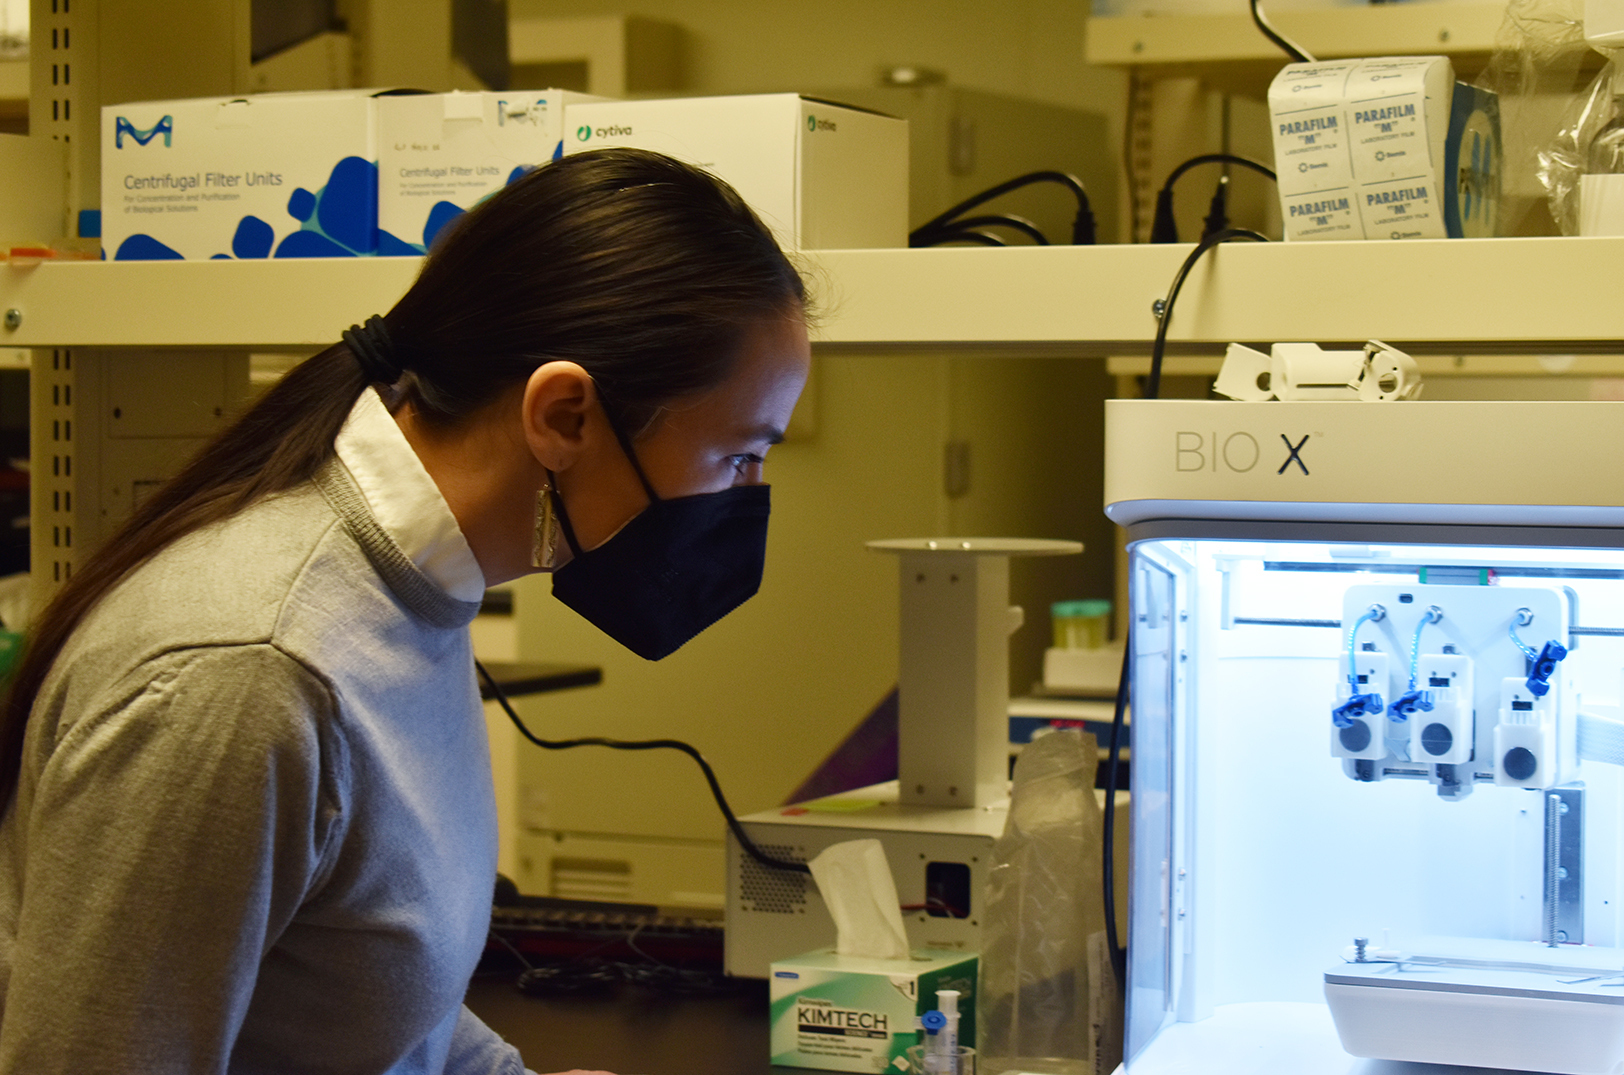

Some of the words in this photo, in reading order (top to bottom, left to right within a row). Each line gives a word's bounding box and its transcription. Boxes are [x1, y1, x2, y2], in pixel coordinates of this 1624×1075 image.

[1355, 103, 1415, 124] PARAFILM
[596, 125, 632, 138] cytiva
[1279, 116, 1338, 136] PARAFILM
[124, 173, 200, 192] Centrifugal
[205, 172, 241, 188] Filter
[245, 171, 283, 187] Units
[399, 167, 447, 179] Centrifugal
[450, 166, 473, 176] Filter
[476, 166, 500, 176] Units
[1366, 187, 1428, 207] PARAFILM
[1289, 198, 1349, 217] PARAFILM
[1176, 431, 1260, 473] BIO
[1277, 433, 1309, 476] X
[910, 981, 915, 995] 1
[798, 1007, 888, 1030] KIMTECH
